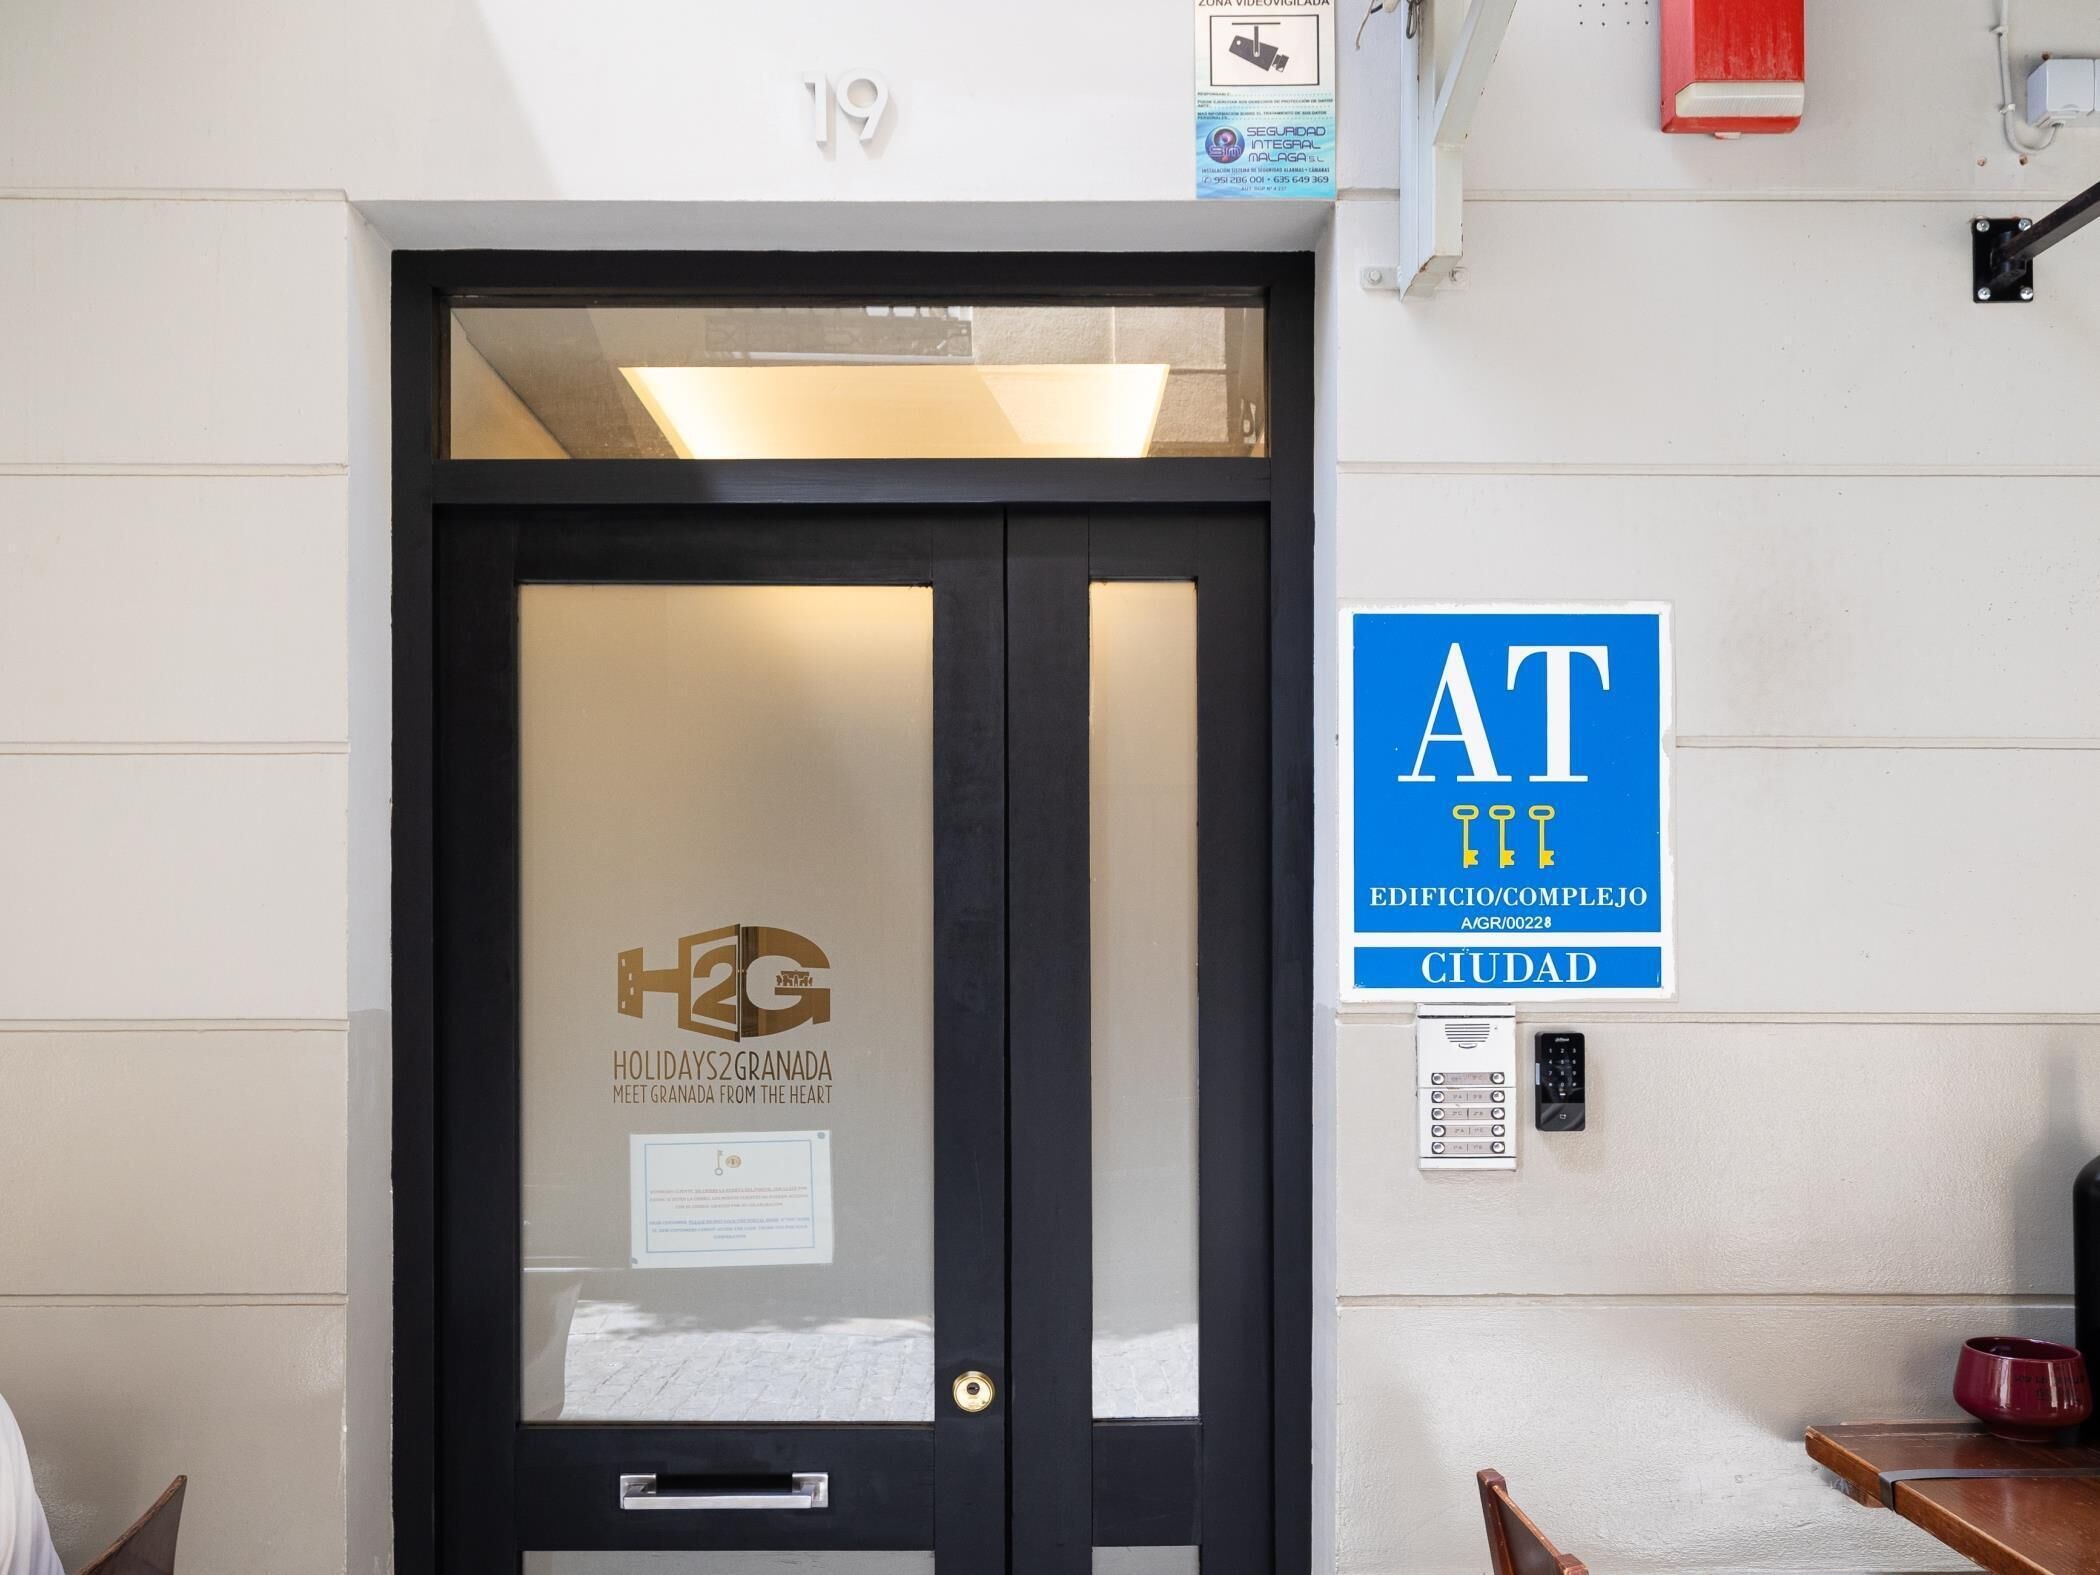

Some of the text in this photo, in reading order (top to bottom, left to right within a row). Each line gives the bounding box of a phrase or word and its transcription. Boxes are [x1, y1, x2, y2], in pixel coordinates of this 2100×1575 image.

[802, 68, 889, 144] 19
[1246, 126, 1326, 137] SEGURIDAD
[1251, 139, 1321, 150] INTEGRAL
[1248, 152, 1307, 163] MALAGA
[1214, 176, 1229, 184] 951
[1273, 175, 1290, 183] 635
[1292, 175, 1310, 183] 649
[1311, 175, 1329, 183] 369
[1397, 642, 1610, 782] AT
[1369, 886, 1647, 907] EDIFICIO/COMPLEJO
[1461, 916, 1552, 930] A/GR/00228
[1421, 952, 1597, 984] CIUDAD
[614, 1050, 832, 1081] HOLIDAYS2GRANADA
[613, 1085, 832, 1104] MEET GRANADA FROM THE HEART
